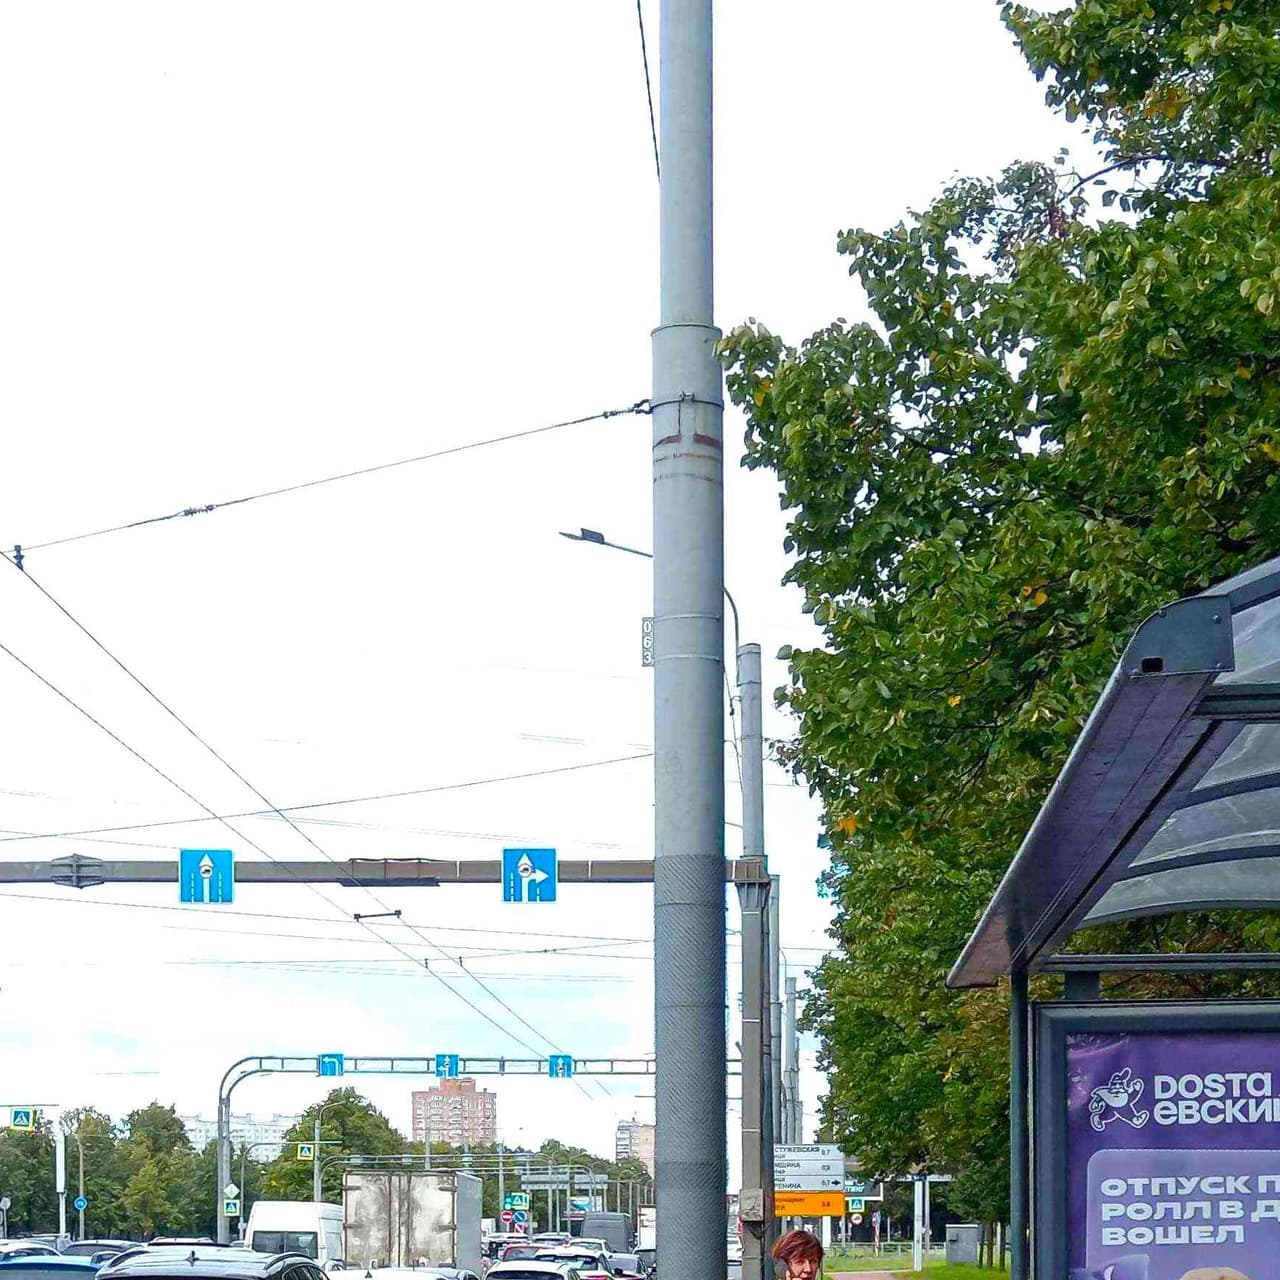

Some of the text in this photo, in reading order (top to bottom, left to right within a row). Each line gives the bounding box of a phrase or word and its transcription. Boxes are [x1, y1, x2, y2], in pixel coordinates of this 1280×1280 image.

[1100, 1175, 1251, 1197] ОТПУСК
[1102, 1201, 1212, 1221] РОЛЛ
[1219, 1200, 1245, 1219] В
[1102, 1225, 1245, 1246] ВОШЕЛ
